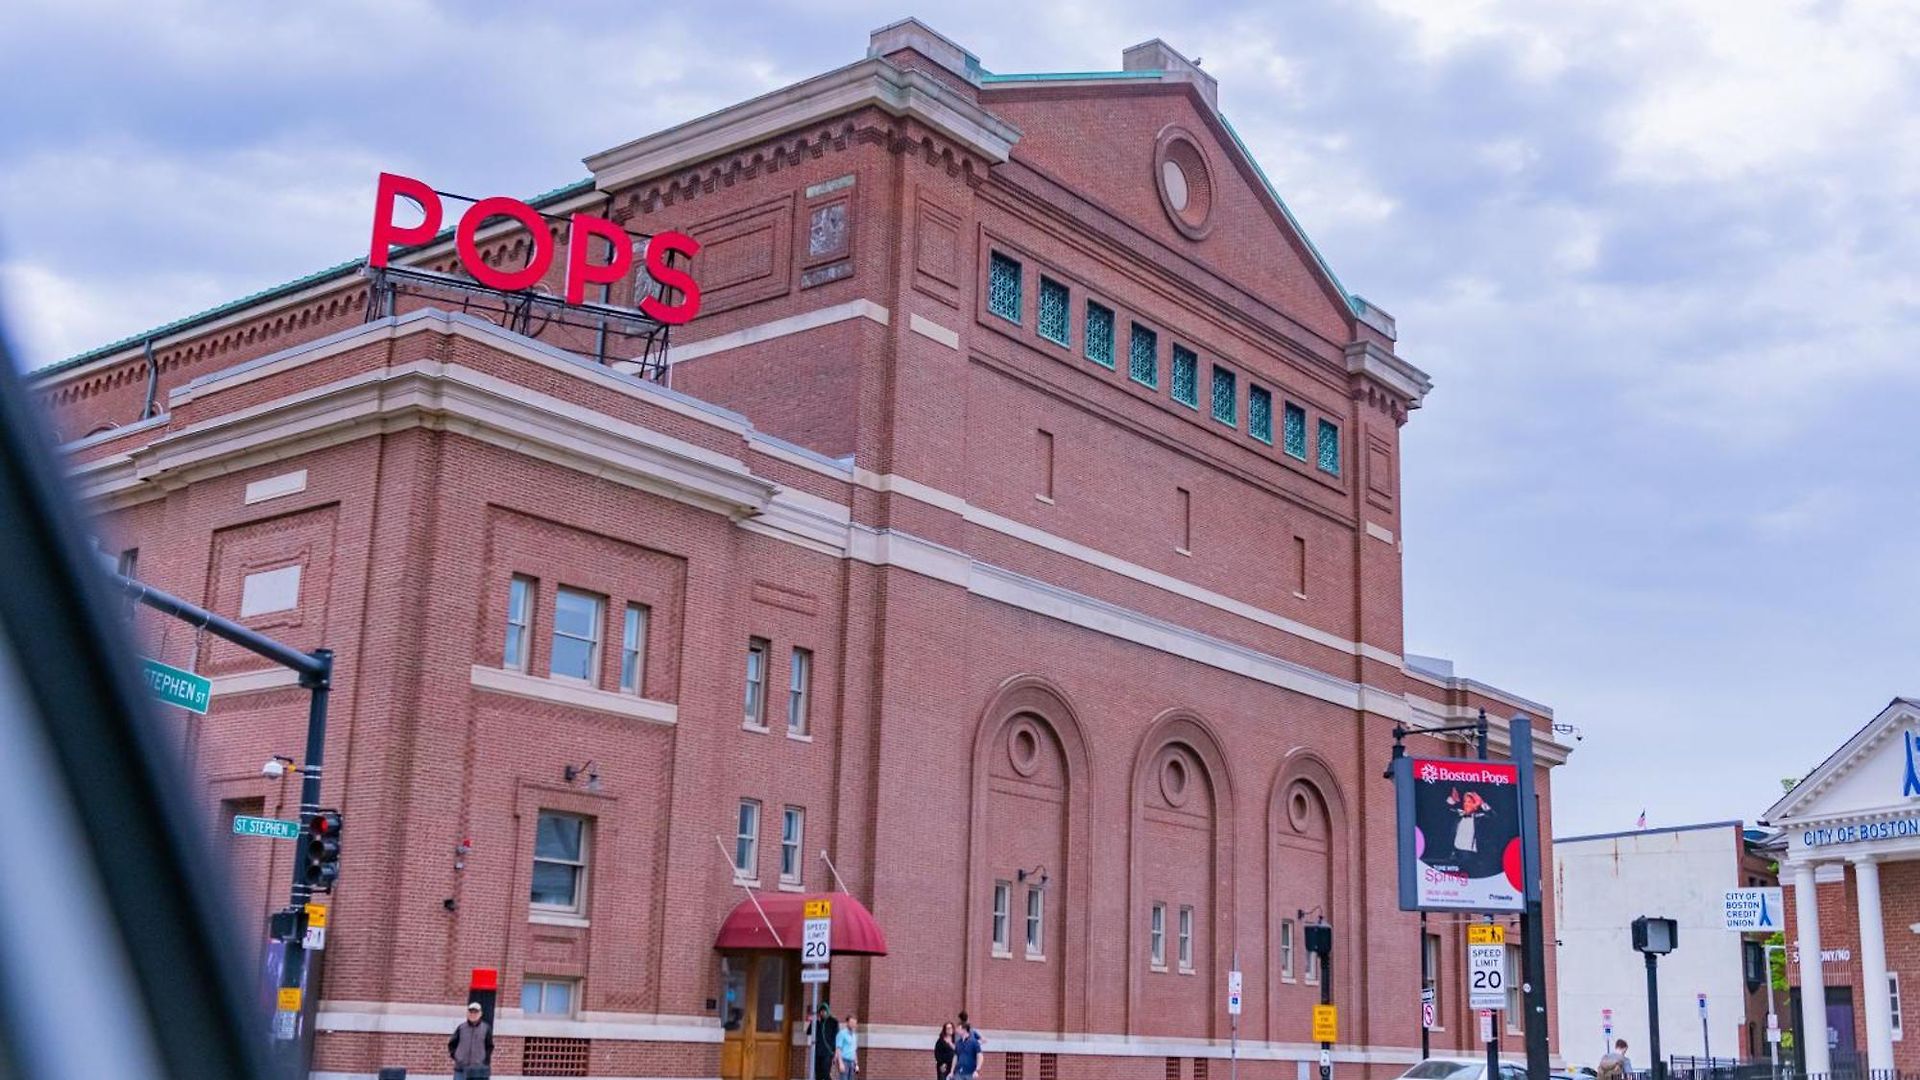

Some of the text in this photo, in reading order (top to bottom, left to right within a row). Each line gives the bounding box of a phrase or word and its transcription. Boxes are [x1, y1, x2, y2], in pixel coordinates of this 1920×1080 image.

[369, 172, 701, 325] POPS
[195, 692, 206, 704] ST
[1440, 768, 1509, 786] Boston Pops
[236, 819, 247, 831] ST
[249, 821, 288, 836] STEPHEN
[1804, 819, 1919, 846] CITY OF BOSTON
[1425, 868, 1469, 887] Spring
[1726, 892, 1757, 900] CITY OF
[1726, 910, 1756, 918] CREDIT
[806, 941, 827, 957] 20
[1472, 949, 1501, 957] SPEED
[1475, 959, 1498, 967] LIMIT
[1474, 970, 1502, 989] 20
